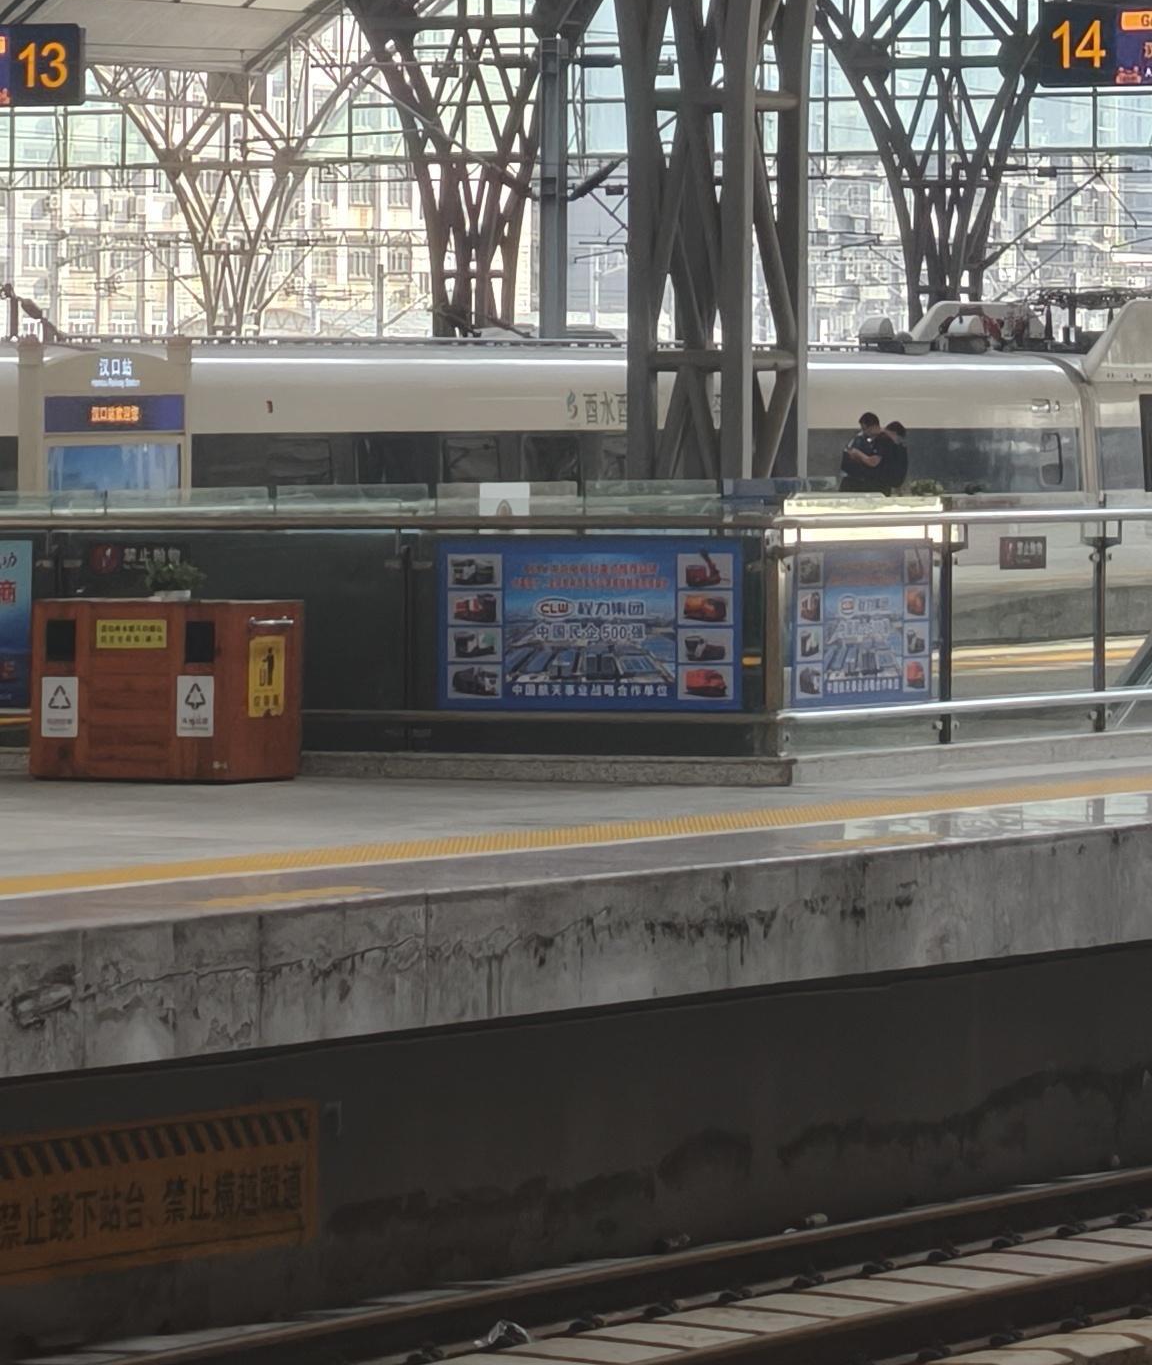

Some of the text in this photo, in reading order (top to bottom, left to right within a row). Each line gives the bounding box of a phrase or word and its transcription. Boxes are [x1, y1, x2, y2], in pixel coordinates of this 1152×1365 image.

[18, 41, 68, 89] 13
[1052, 19, 1106, 70] 14
[98, 357, 133, 377] 汉口站
